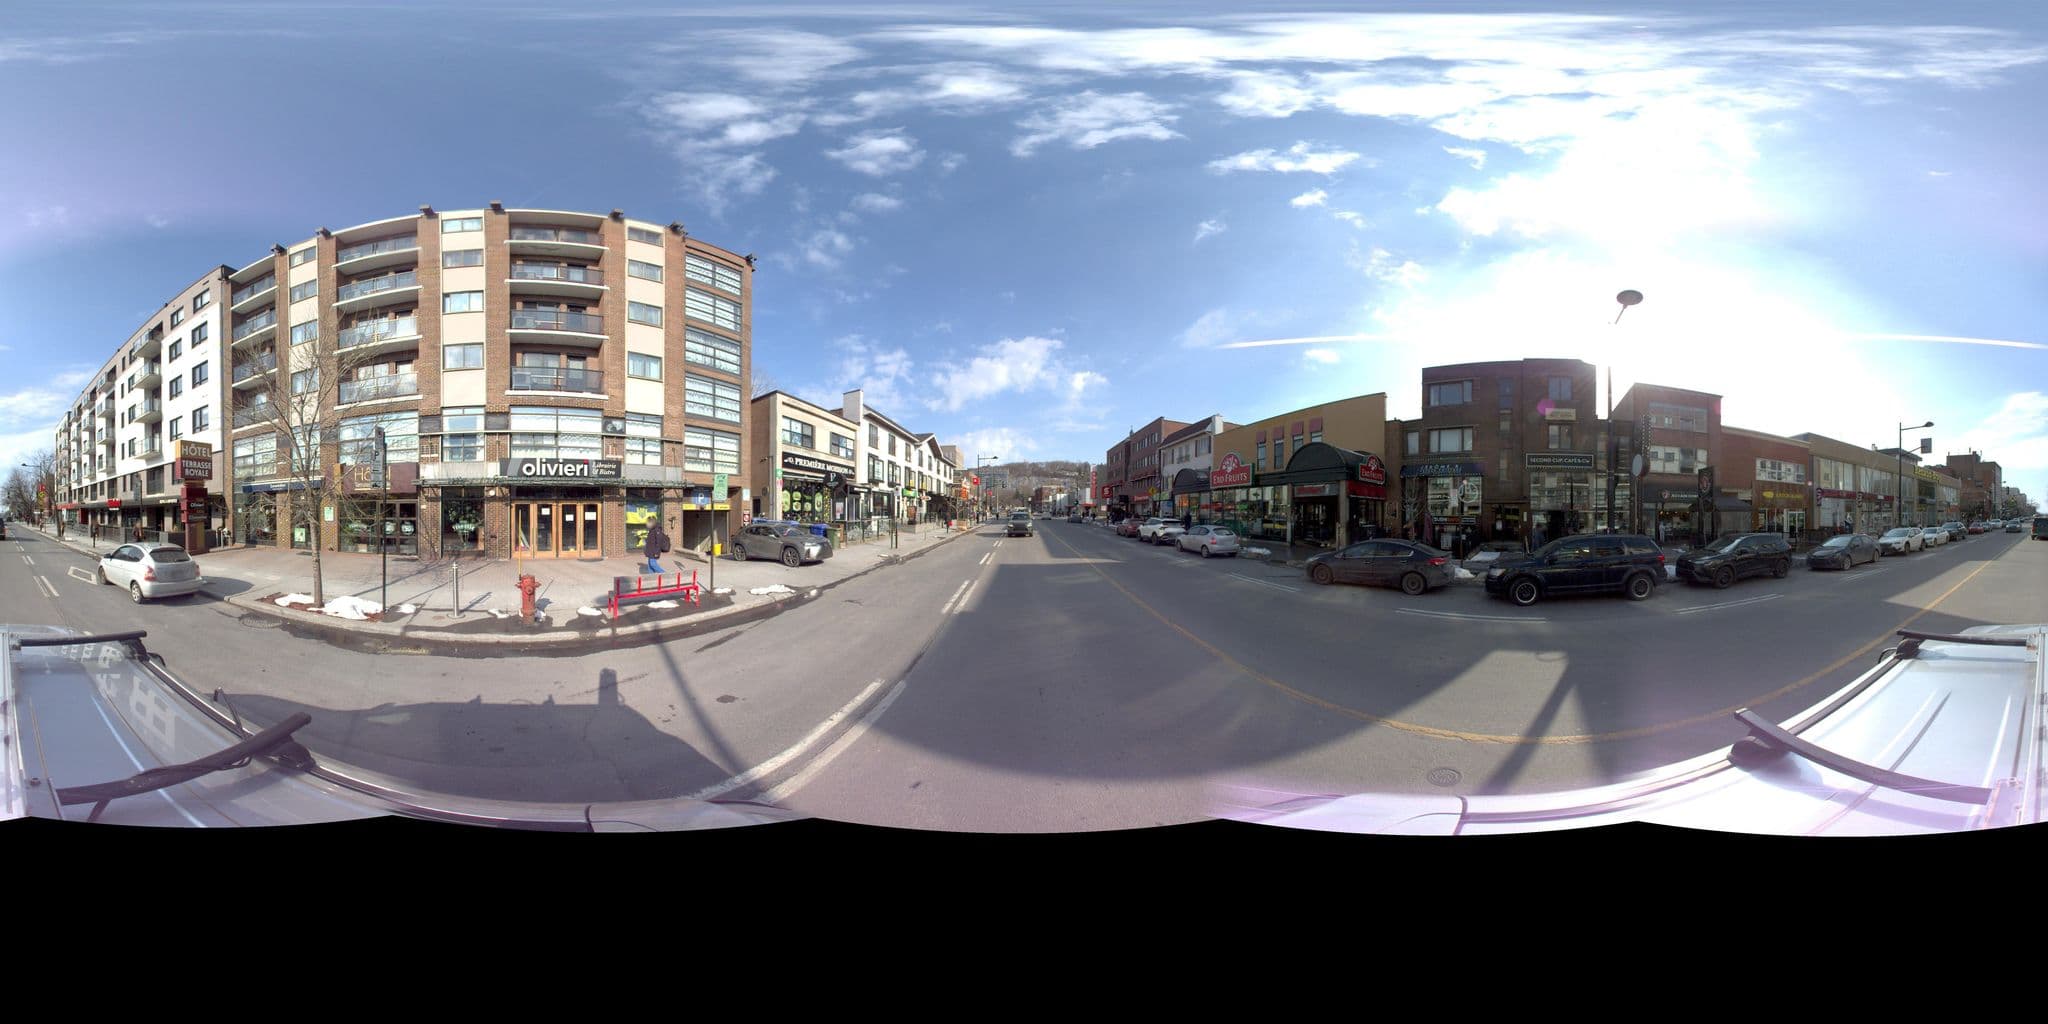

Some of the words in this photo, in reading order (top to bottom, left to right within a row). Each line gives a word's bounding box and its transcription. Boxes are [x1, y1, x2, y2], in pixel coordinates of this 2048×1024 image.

[182, 443, 211, 457] HÔTEL
[182, 460, 211, 469] TERRASSE
[522, 458, 589, 476] olivieri
[185, 469, 209, 477] ROYALE
[698, 493, 704, 504] P
